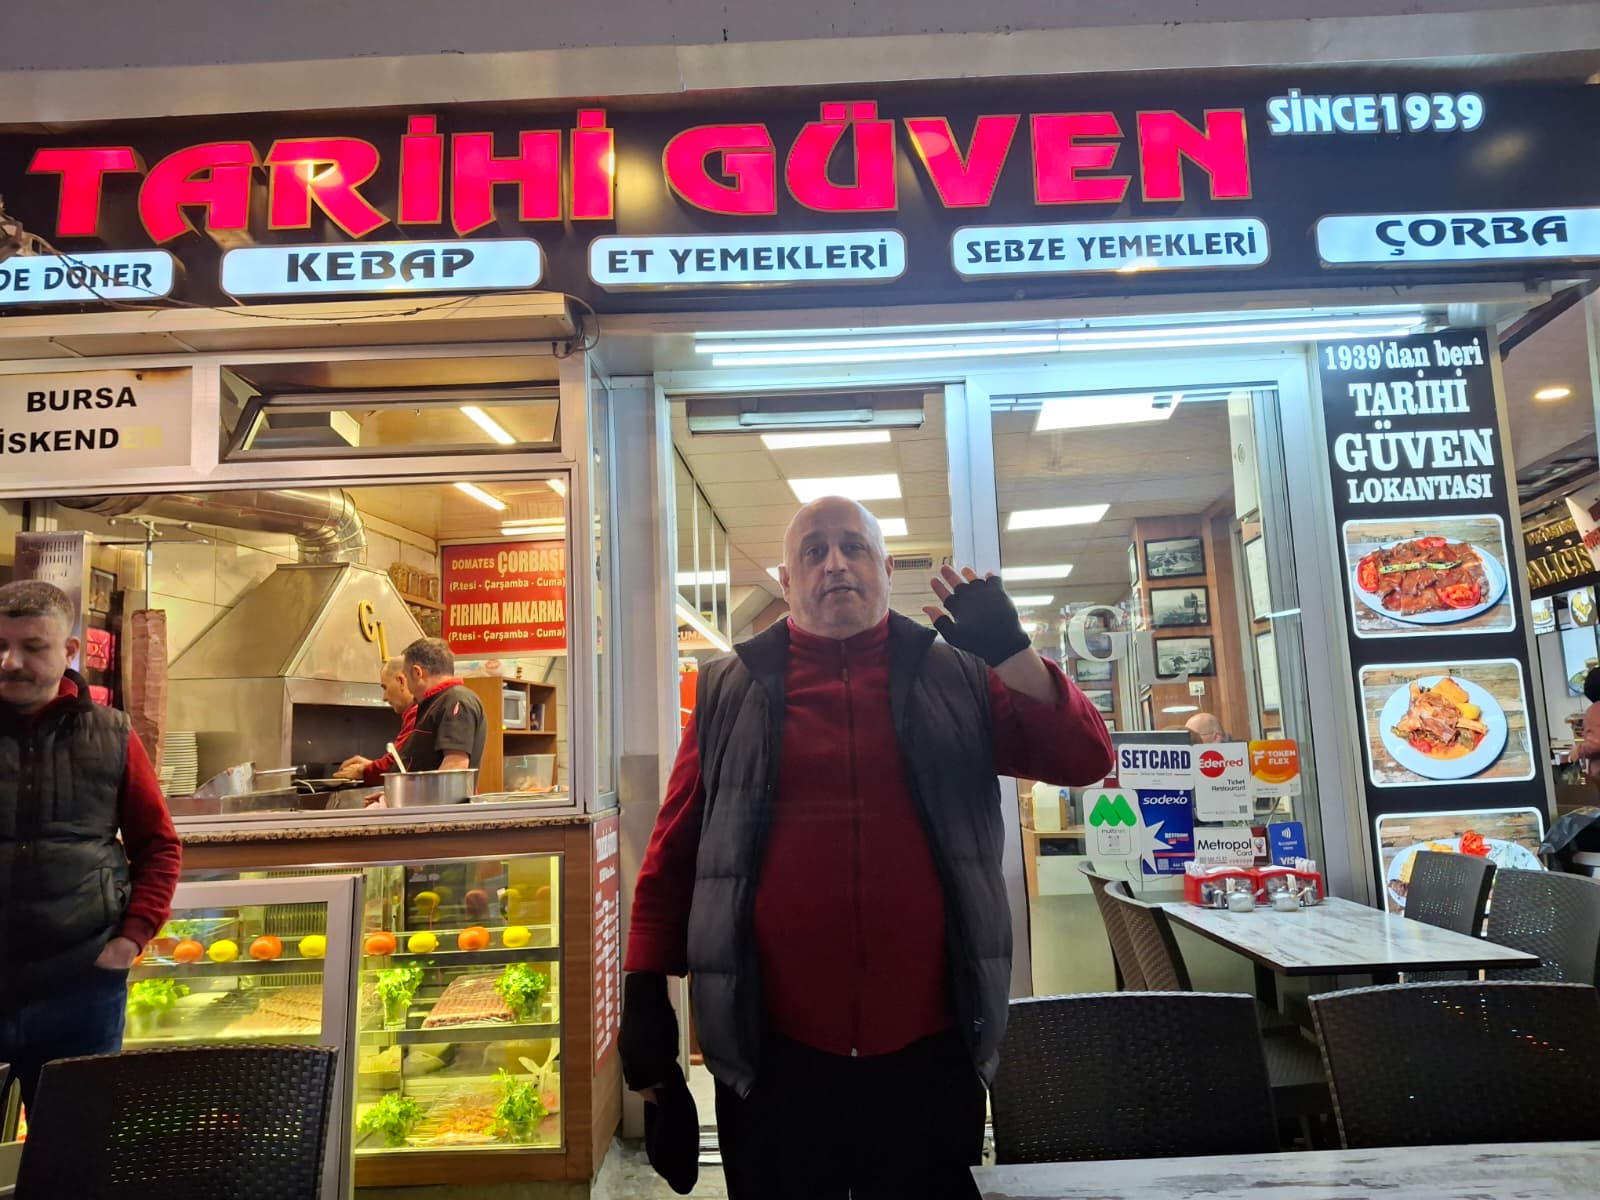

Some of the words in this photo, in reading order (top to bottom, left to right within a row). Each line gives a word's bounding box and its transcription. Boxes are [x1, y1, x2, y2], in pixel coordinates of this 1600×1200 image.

[26, 109, 614, 244] TARİHİ
[662, 101, 1252, 215] GÜVEN
[966, 237, 1066, 264] SEBZE
[1077, 226, 1257, 262] YEMEKLERİ
[1375, 215, 1568, 256] ÇORBA
[286, 247, 475, 283] KEBAP
[608, 248, 654, 273] ET
[669, 238, 888, 275] YEMEKLERİ
[1325, 341, 1430, 370] 1939'dan
[1434, 337, 1484, 368] beri
[27, 387, 137, 412] BURSA
[1348, 368, 1471, 416] TARİHİ
[1335, 420, 1495, 472] GÜVEN
[1347, 474, 1493, 503] LOKANTASI
[451, 558, 495, 570] DOMATES
[497, 549, 565, 577] ÇORBASI
[484, 578, 529, 591] Çarşamba
[537, 577, 566, 588] Cuma)
[450, 602, 499, 626] FIRINDA
[502, 600, 564, 624] MAKARNA
[483, 629, 529, 641] Çarşamba
[536, 627, 566, 638] Cuma)
[1121, 749, 1191, 770] SETCARD
[1199, 757, 1243, 769] Edenred
[1143, 793, 1188, 805] sodexo
[1198, 838, 1252, 851] Metropol
[1280, 856, 1295, 865] VIS
